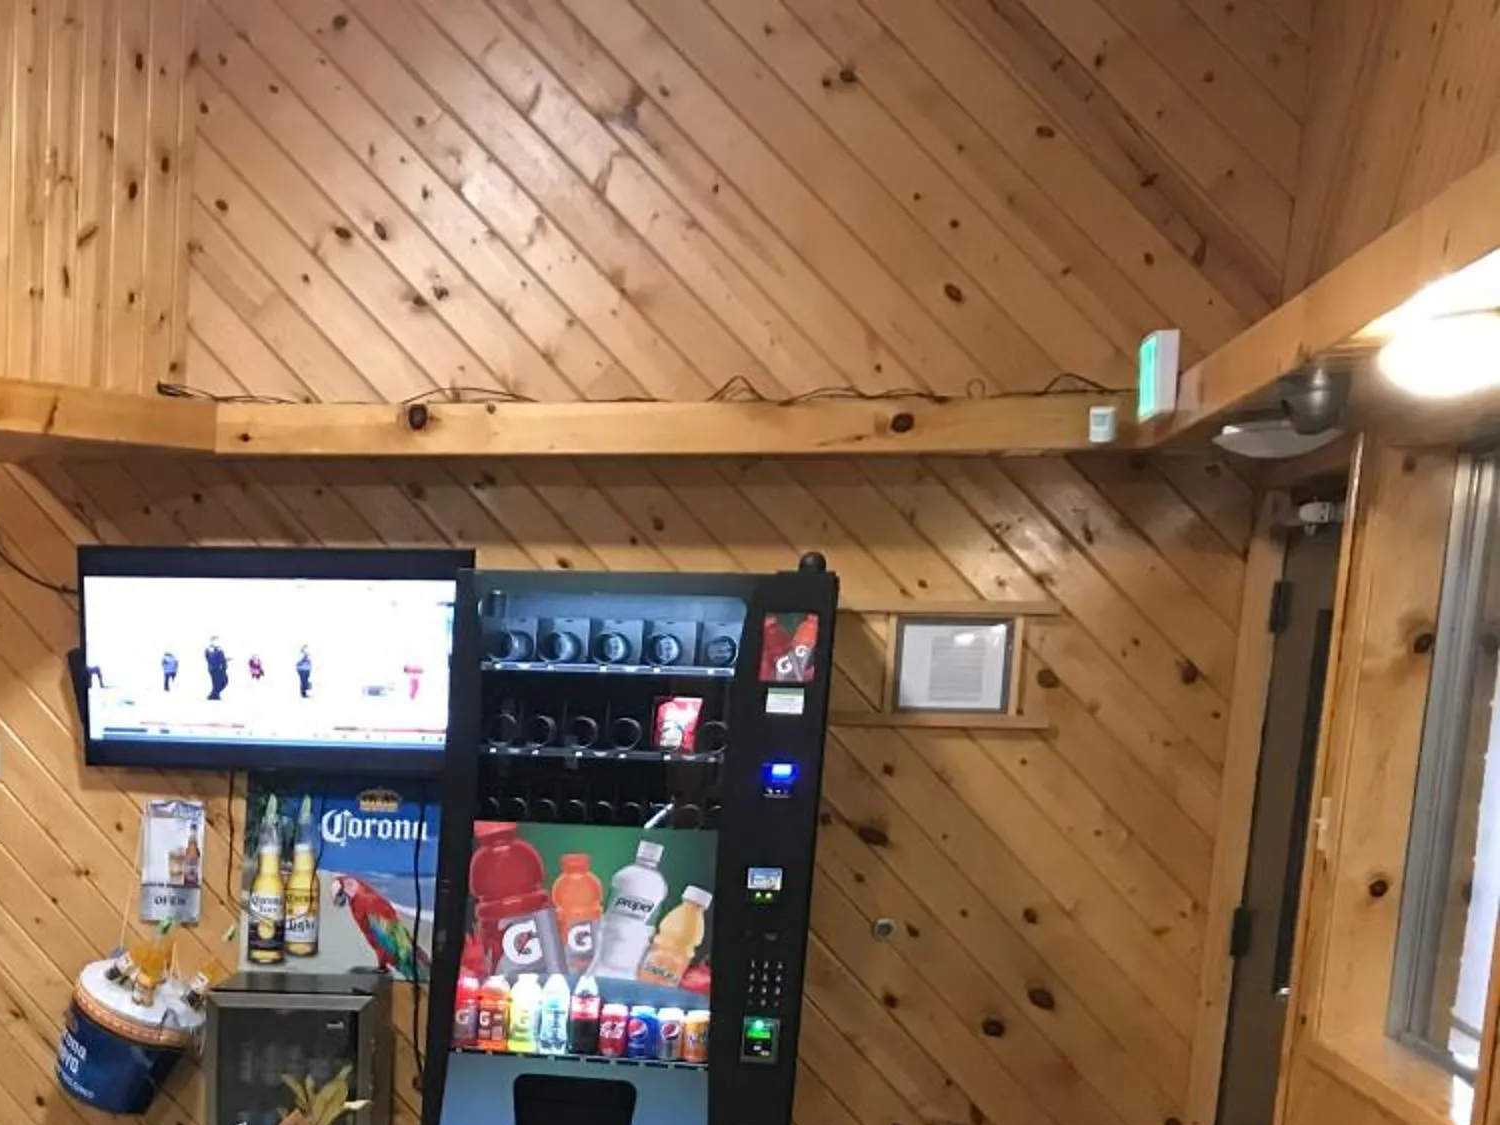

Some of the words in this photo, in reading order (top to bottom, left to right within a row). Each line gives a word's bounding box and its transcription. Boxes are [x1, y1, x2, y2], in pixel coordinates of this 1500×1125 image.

[776, 655, 793, 674] G
[321, 808, 428, 848] Corona
[613, 896, 655, 912] propel
[502, 918, 543, 965] G
[567, 923, 593, 953] G
